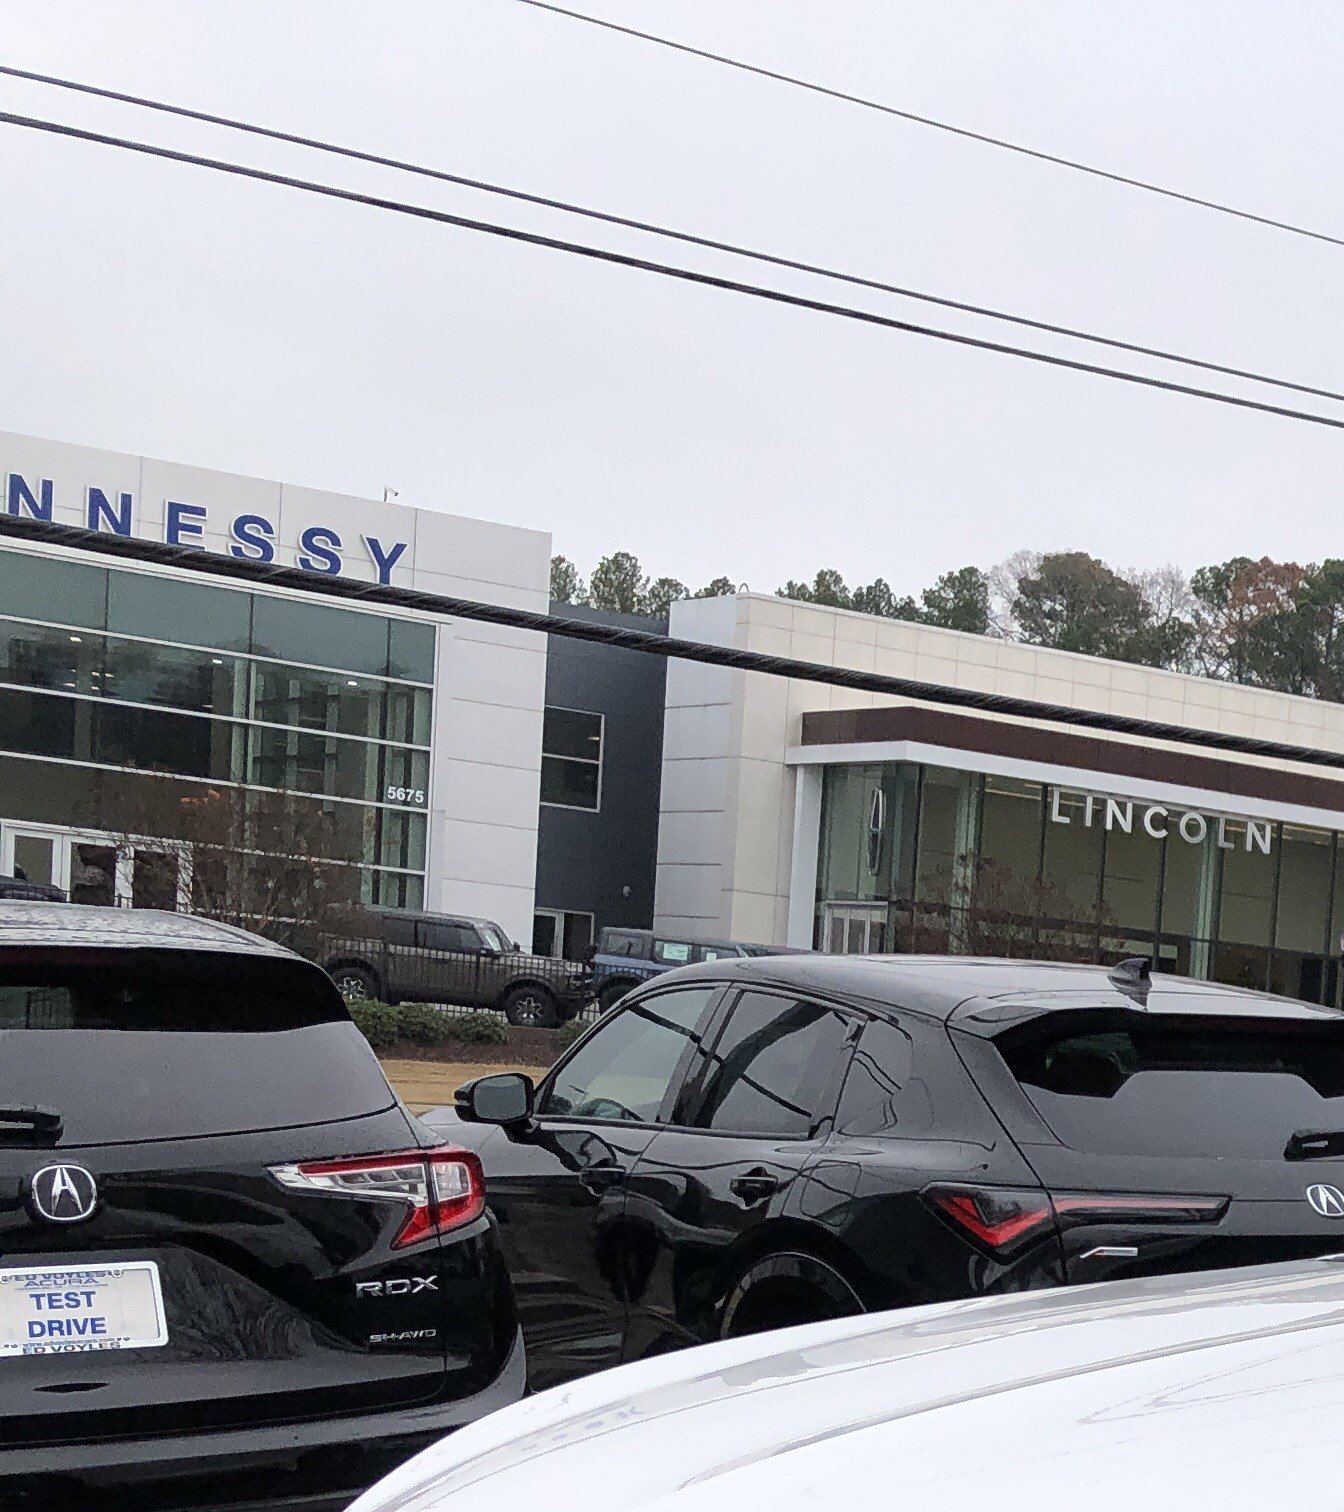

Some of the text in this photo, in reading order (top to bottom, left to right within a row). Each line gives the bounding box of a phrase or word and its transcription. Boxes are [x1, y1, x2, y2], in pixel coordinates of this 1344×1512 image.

[387, 785, 425, 804] 5675
[1051, 785, 1272, 855] LINCOLN
[24, 1277, 99, 1288] ACURA
[355, 1274, 439, 1299] RDX
[29, 1290, 97, 1311] TEST
[27, 1316, 108, 1339] DRIVE
